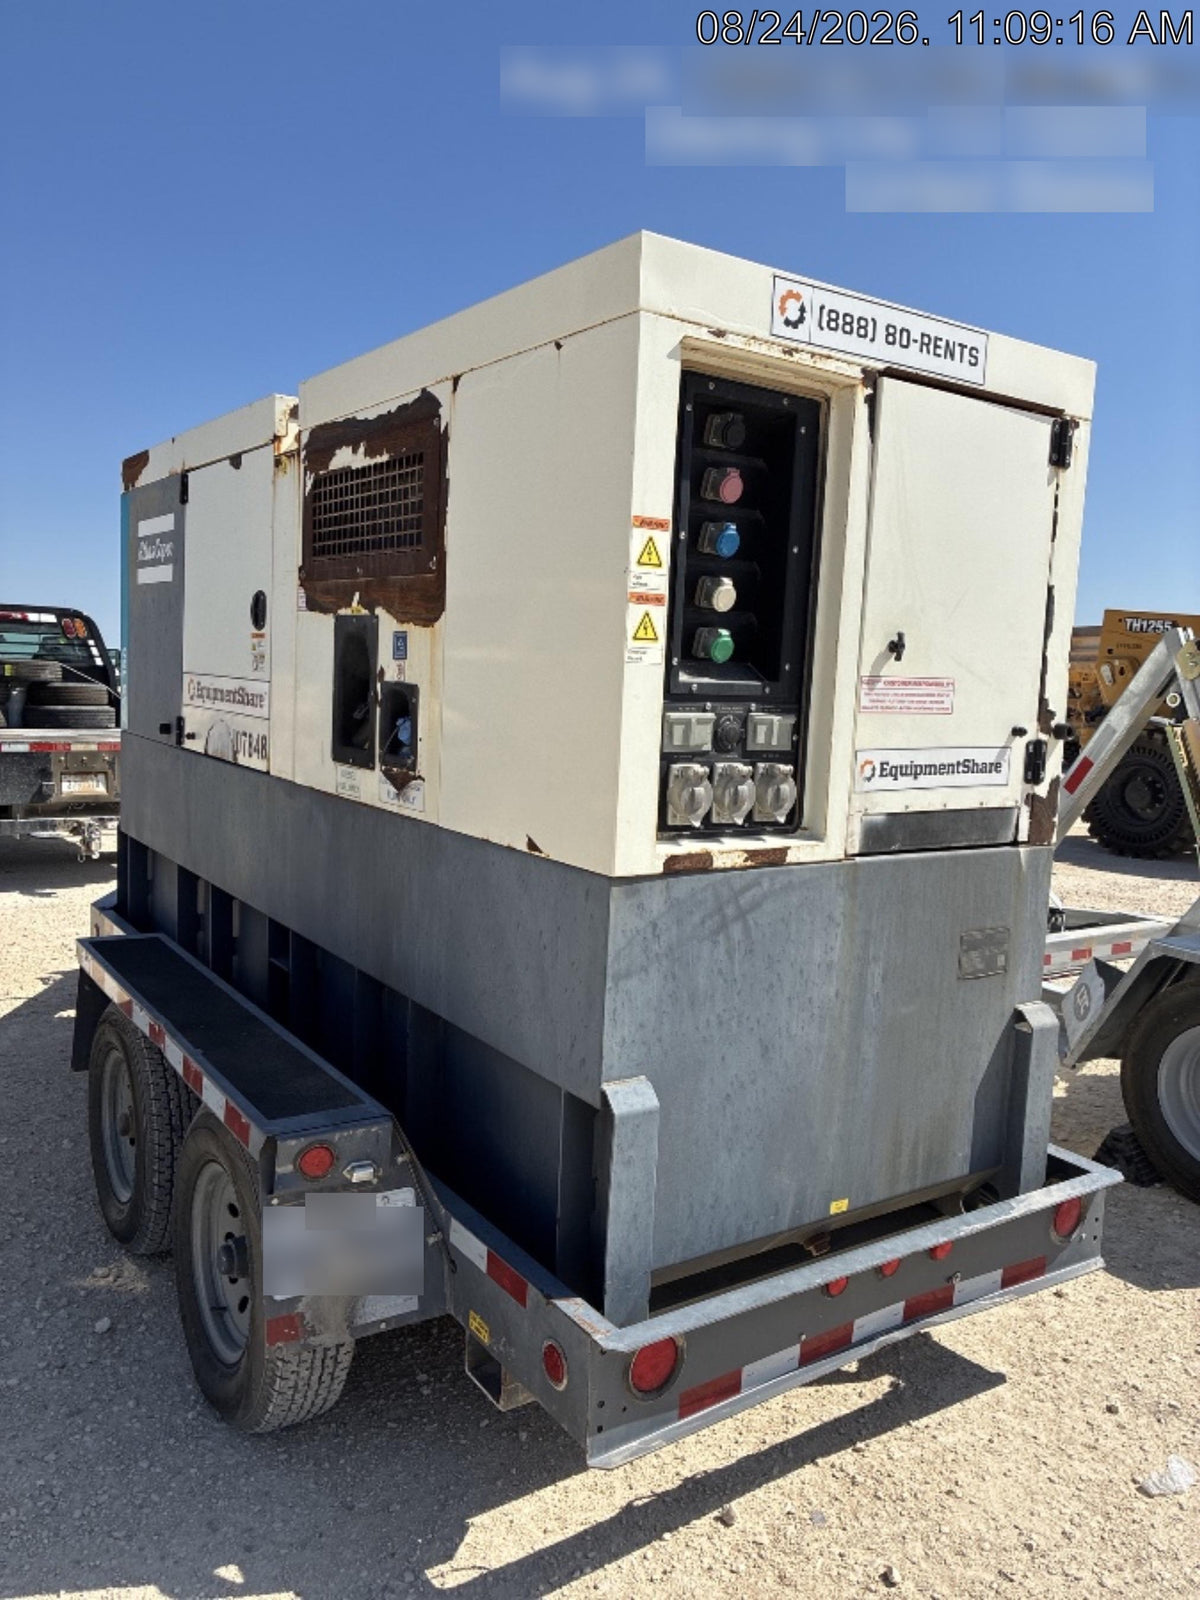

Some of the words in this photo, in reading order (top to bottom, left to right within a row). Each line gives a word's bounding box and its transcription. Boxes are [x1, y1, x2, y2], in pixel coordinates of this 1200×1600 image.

[818, 303, 877, 343] (888)
[884, 322, 980, 367] 80-RENTS
[1124, 617, 1173, 634] TH1255
[196, 681, 264, 709] EquipmentShare
[878, 758, 1003, 781] EquipmentShare
